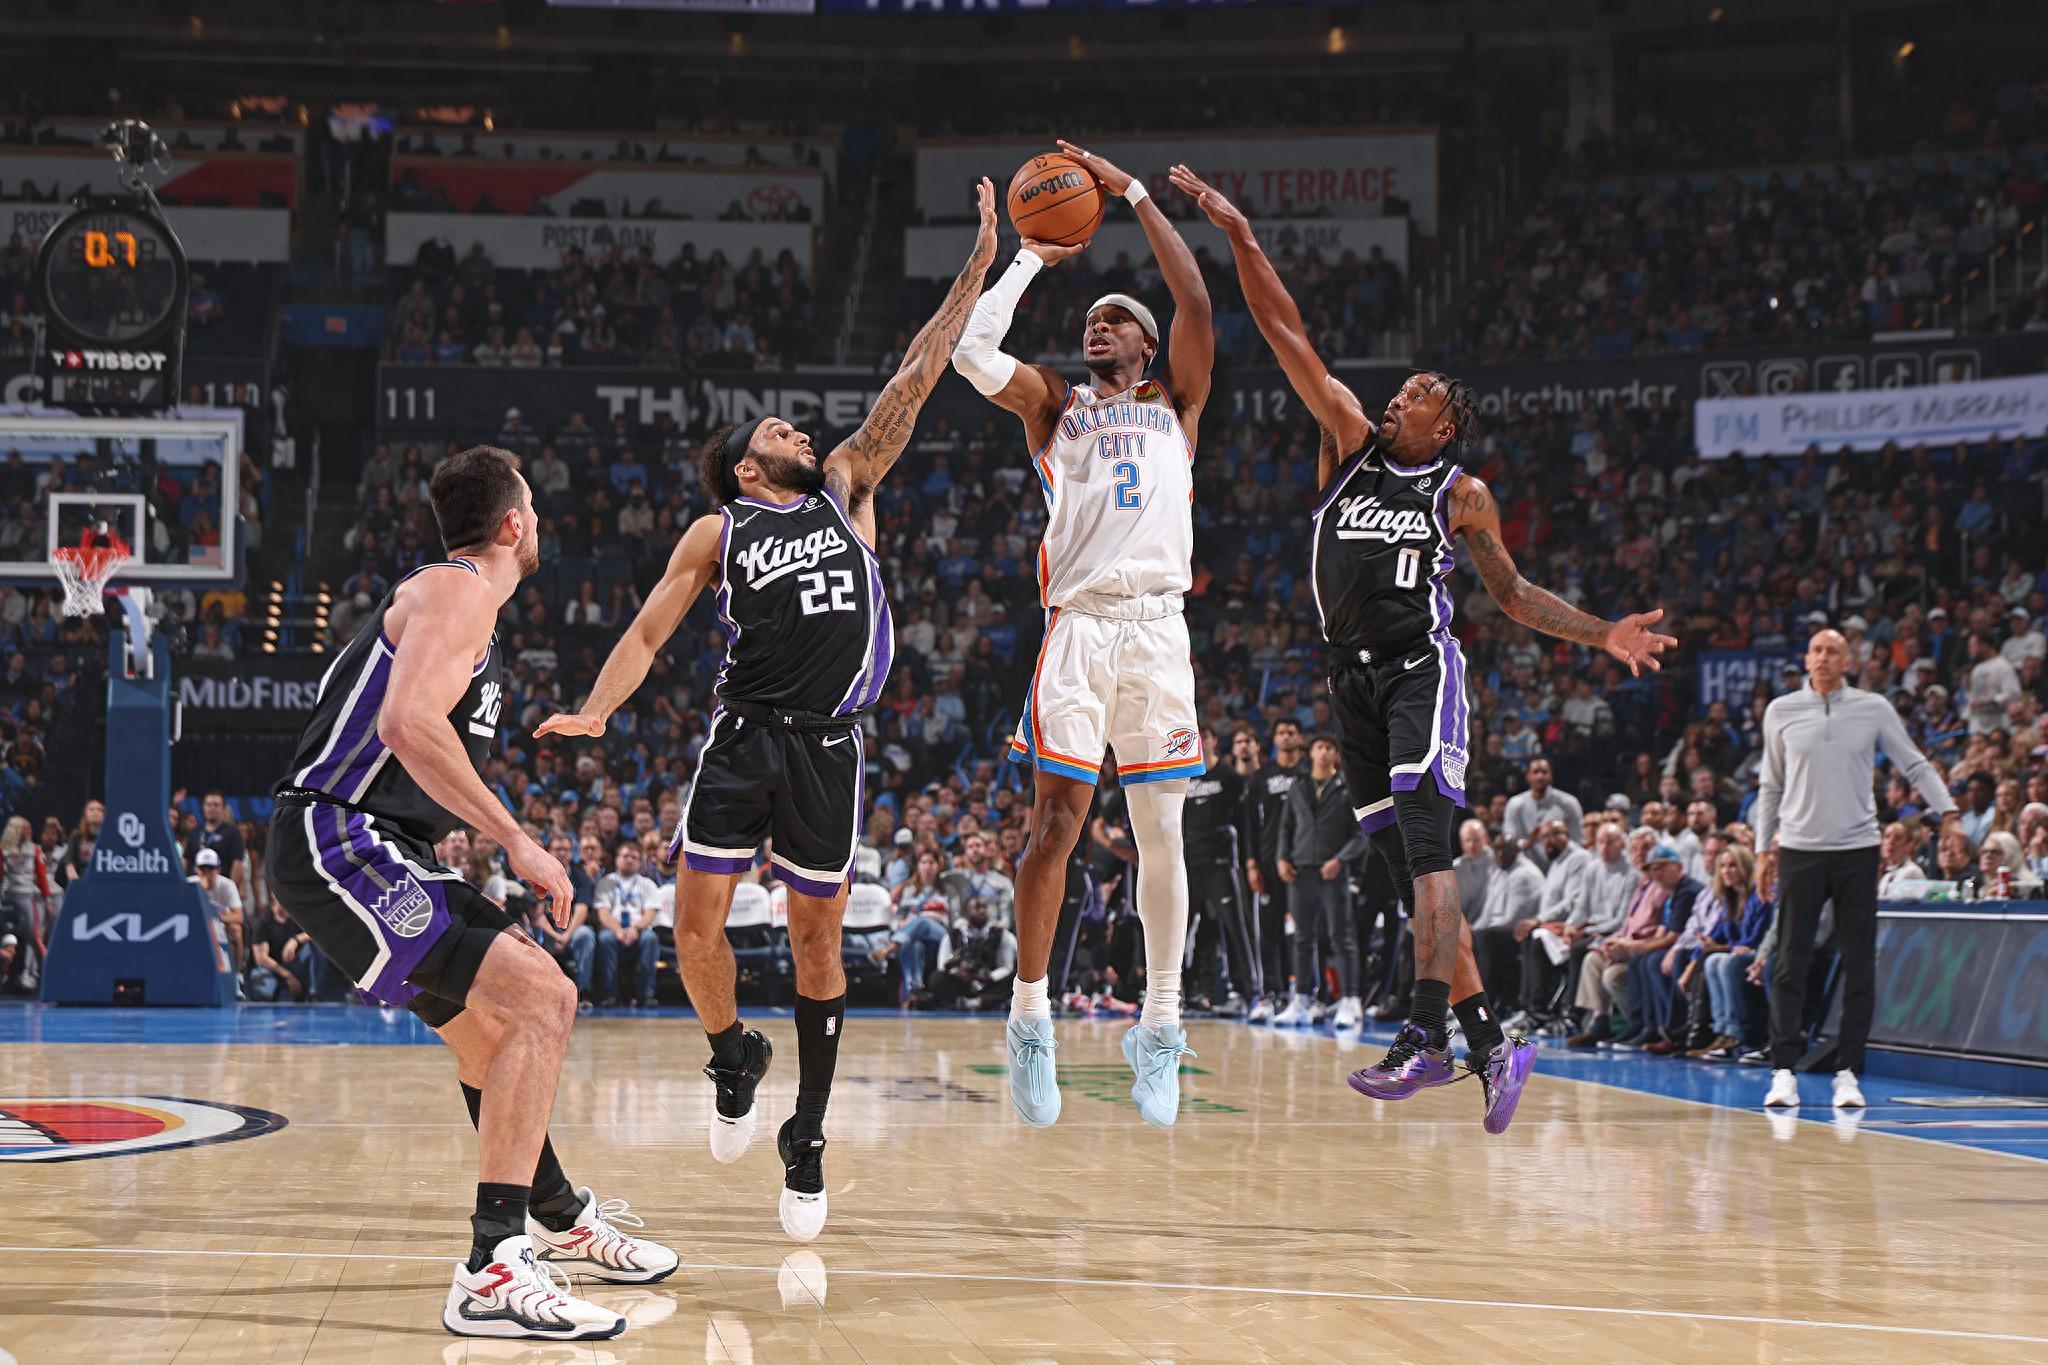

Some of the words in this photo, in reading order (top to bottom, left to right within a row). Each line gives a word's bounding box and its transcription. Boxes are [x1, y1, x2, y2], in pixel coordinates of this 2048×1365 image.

[1020, 171, 1084, 203] Wilson
[1149, 171, 1247, 208] PATY
[1258, 167, 1399, 206] TERRACE
[543, 224, 589, 249] POST
[385, 387, 436, 420] 111
[596, 386, 881, 428] THNDE
[1061, 401, 1173, 440] OKLAHOMA
[1232, 388, 1287, 421] 112
[1098, 432, 1146, 459] CITY
[1113, 460, 1142, 511] 2
[1336, 495, 1431, 543] Kings
[736, 526, 848, 586] Kings
[1394, 547, 1421, 589] 0
[797, 570, 856, 616] 22
[96, 848, 169, 873] Health
[72, 912, 190, 942] KIA
[388, 891, 426, 929] KINGS
[1877, 926, 1979, 1032] OX
